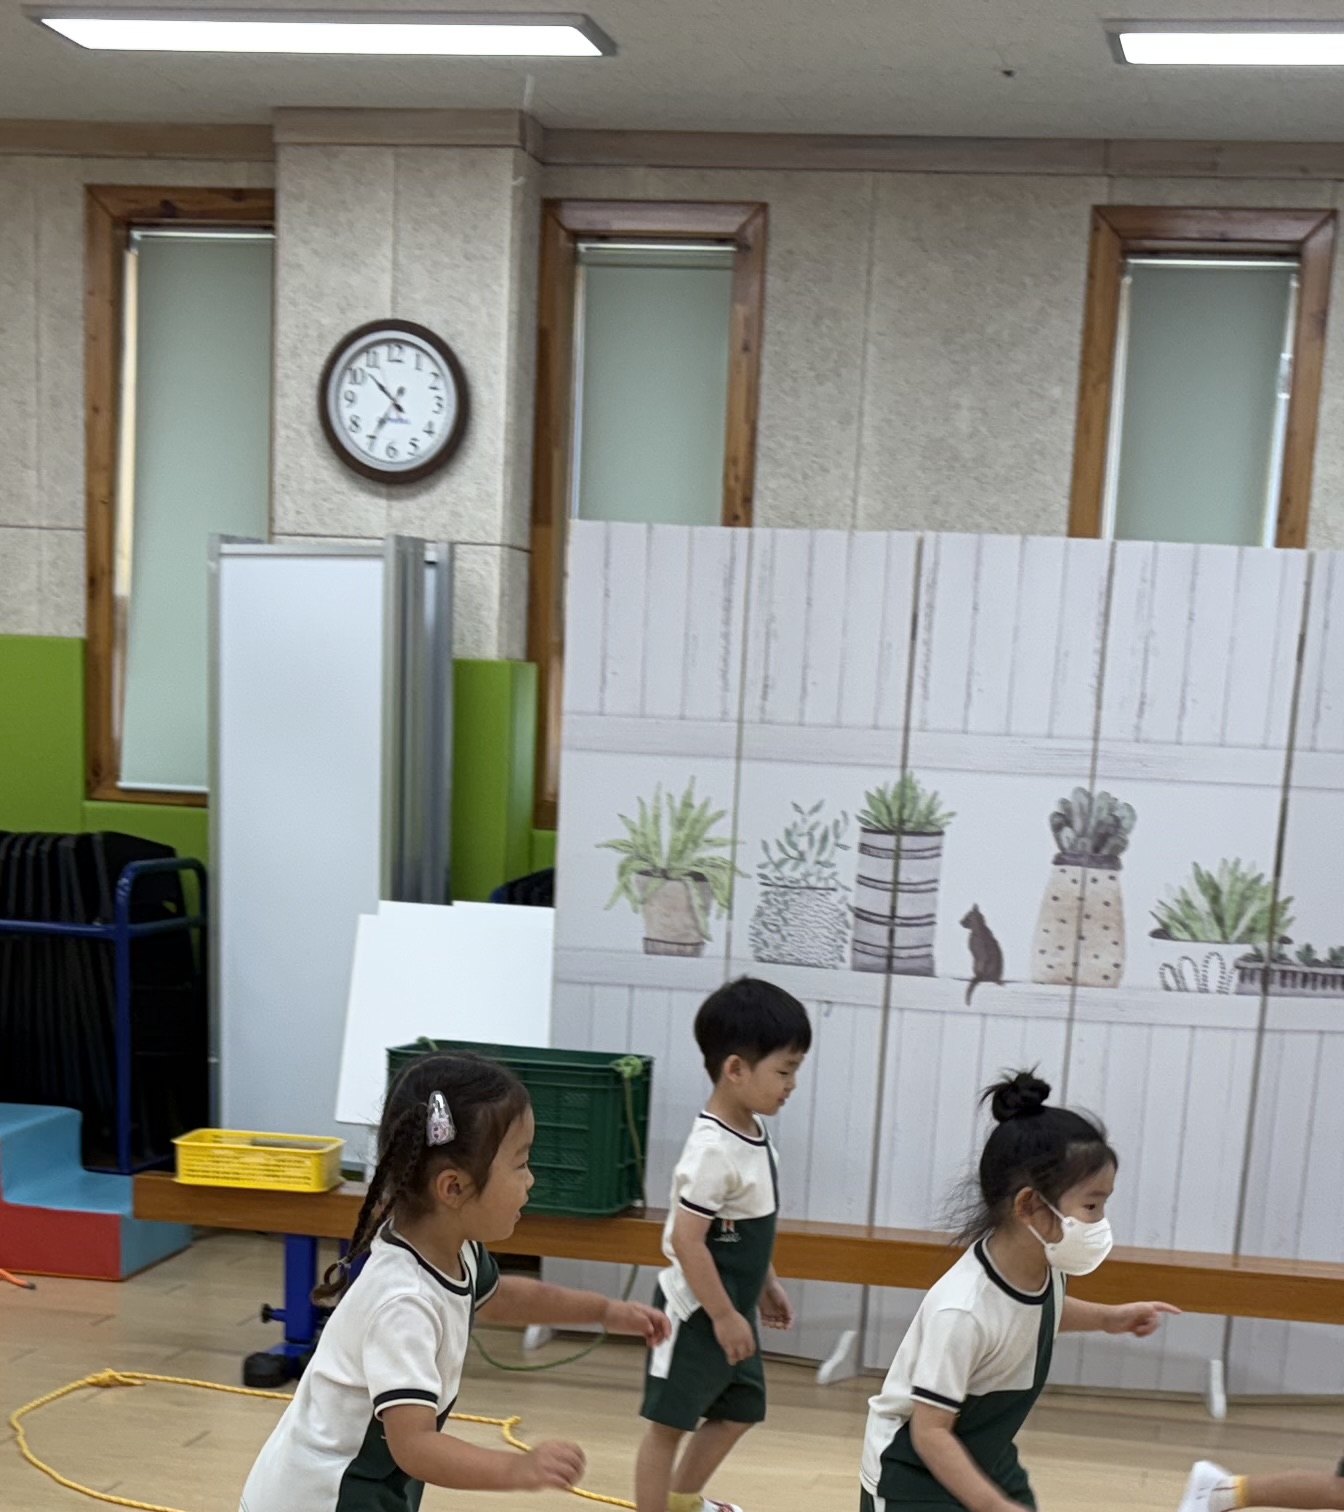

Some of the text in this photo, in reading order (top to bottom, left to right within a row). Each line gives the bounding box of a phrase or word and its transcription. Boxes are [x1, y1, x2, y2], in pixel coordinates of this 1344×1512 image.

[387, 344, 405, 363] 12
[429, 371, 440, 391] 2
[344, 390, 356, 408] 9
[432, 395, 444, 414] 3
[349, 414, 362, 433] 8
[386, 441, 399, 459] 6
